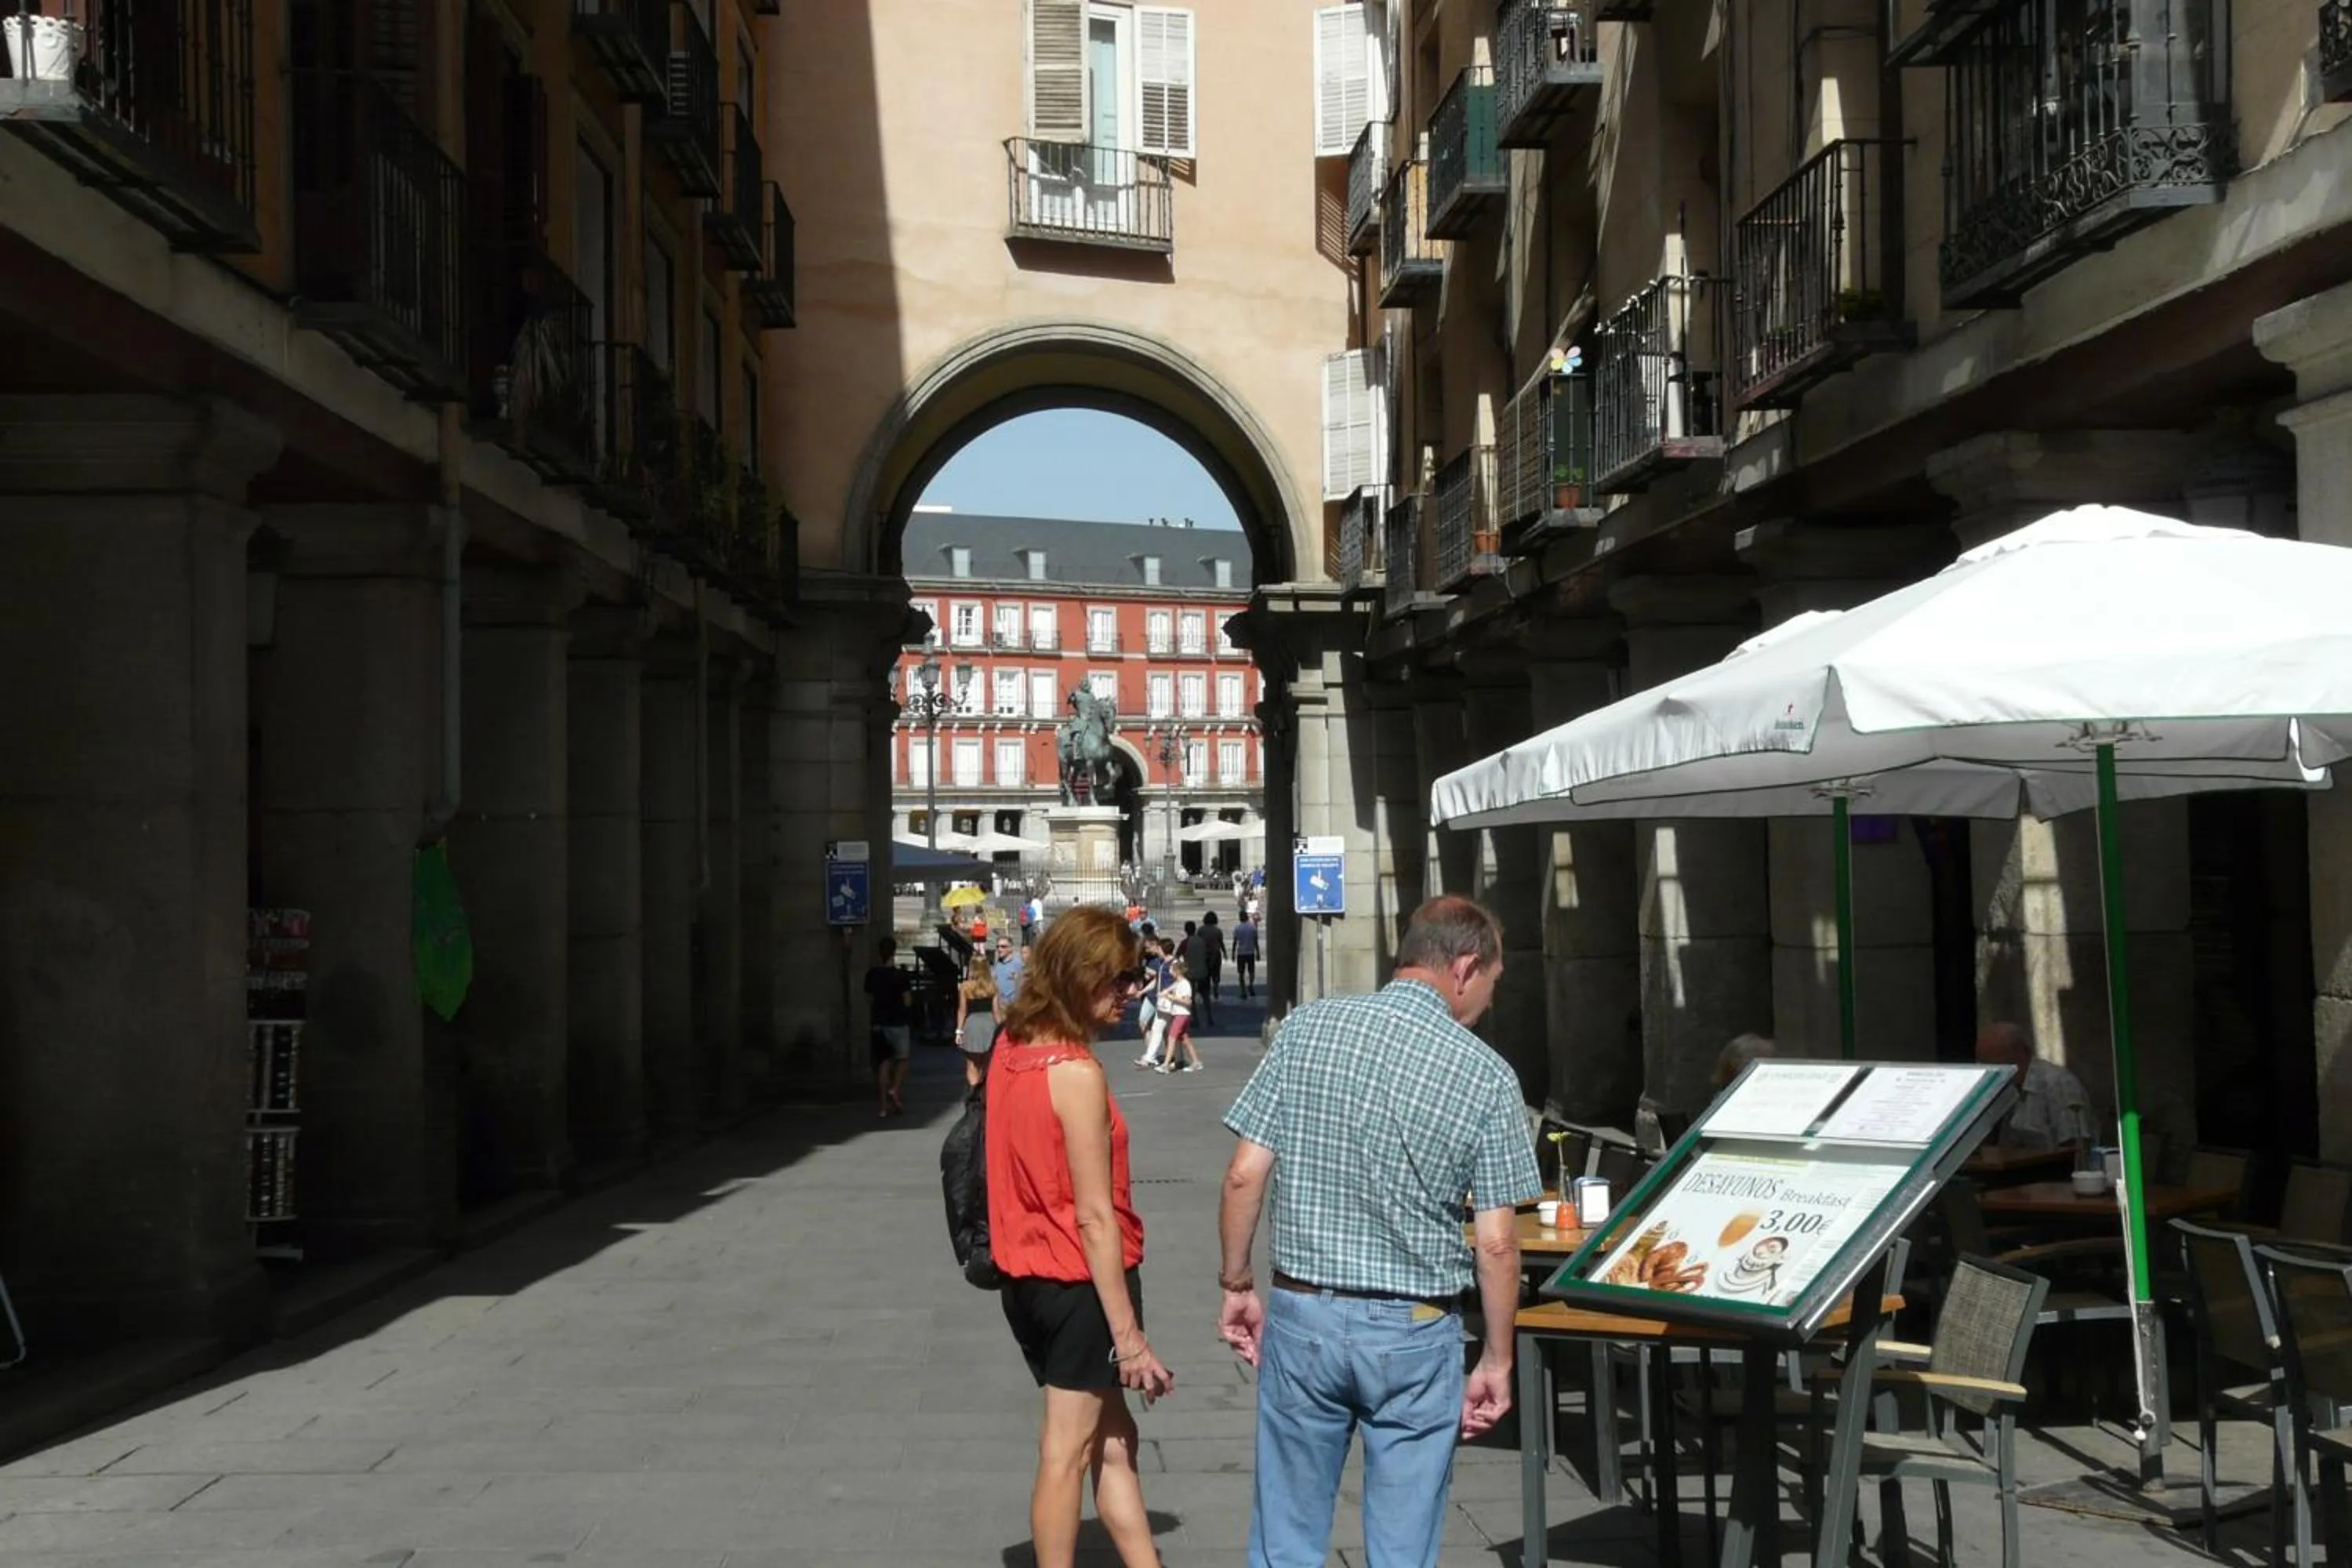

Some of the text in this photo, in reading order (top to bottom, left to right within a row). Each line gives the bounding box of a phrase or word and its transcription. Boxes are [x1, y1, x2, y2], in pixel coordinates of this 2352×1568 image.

[1682, 1171, 1784, 1200] DESAYUNOS
[1780, 1188, 1852, 1207] Breakfast
[1760, 1210, 1832, 1235] 3,00€
